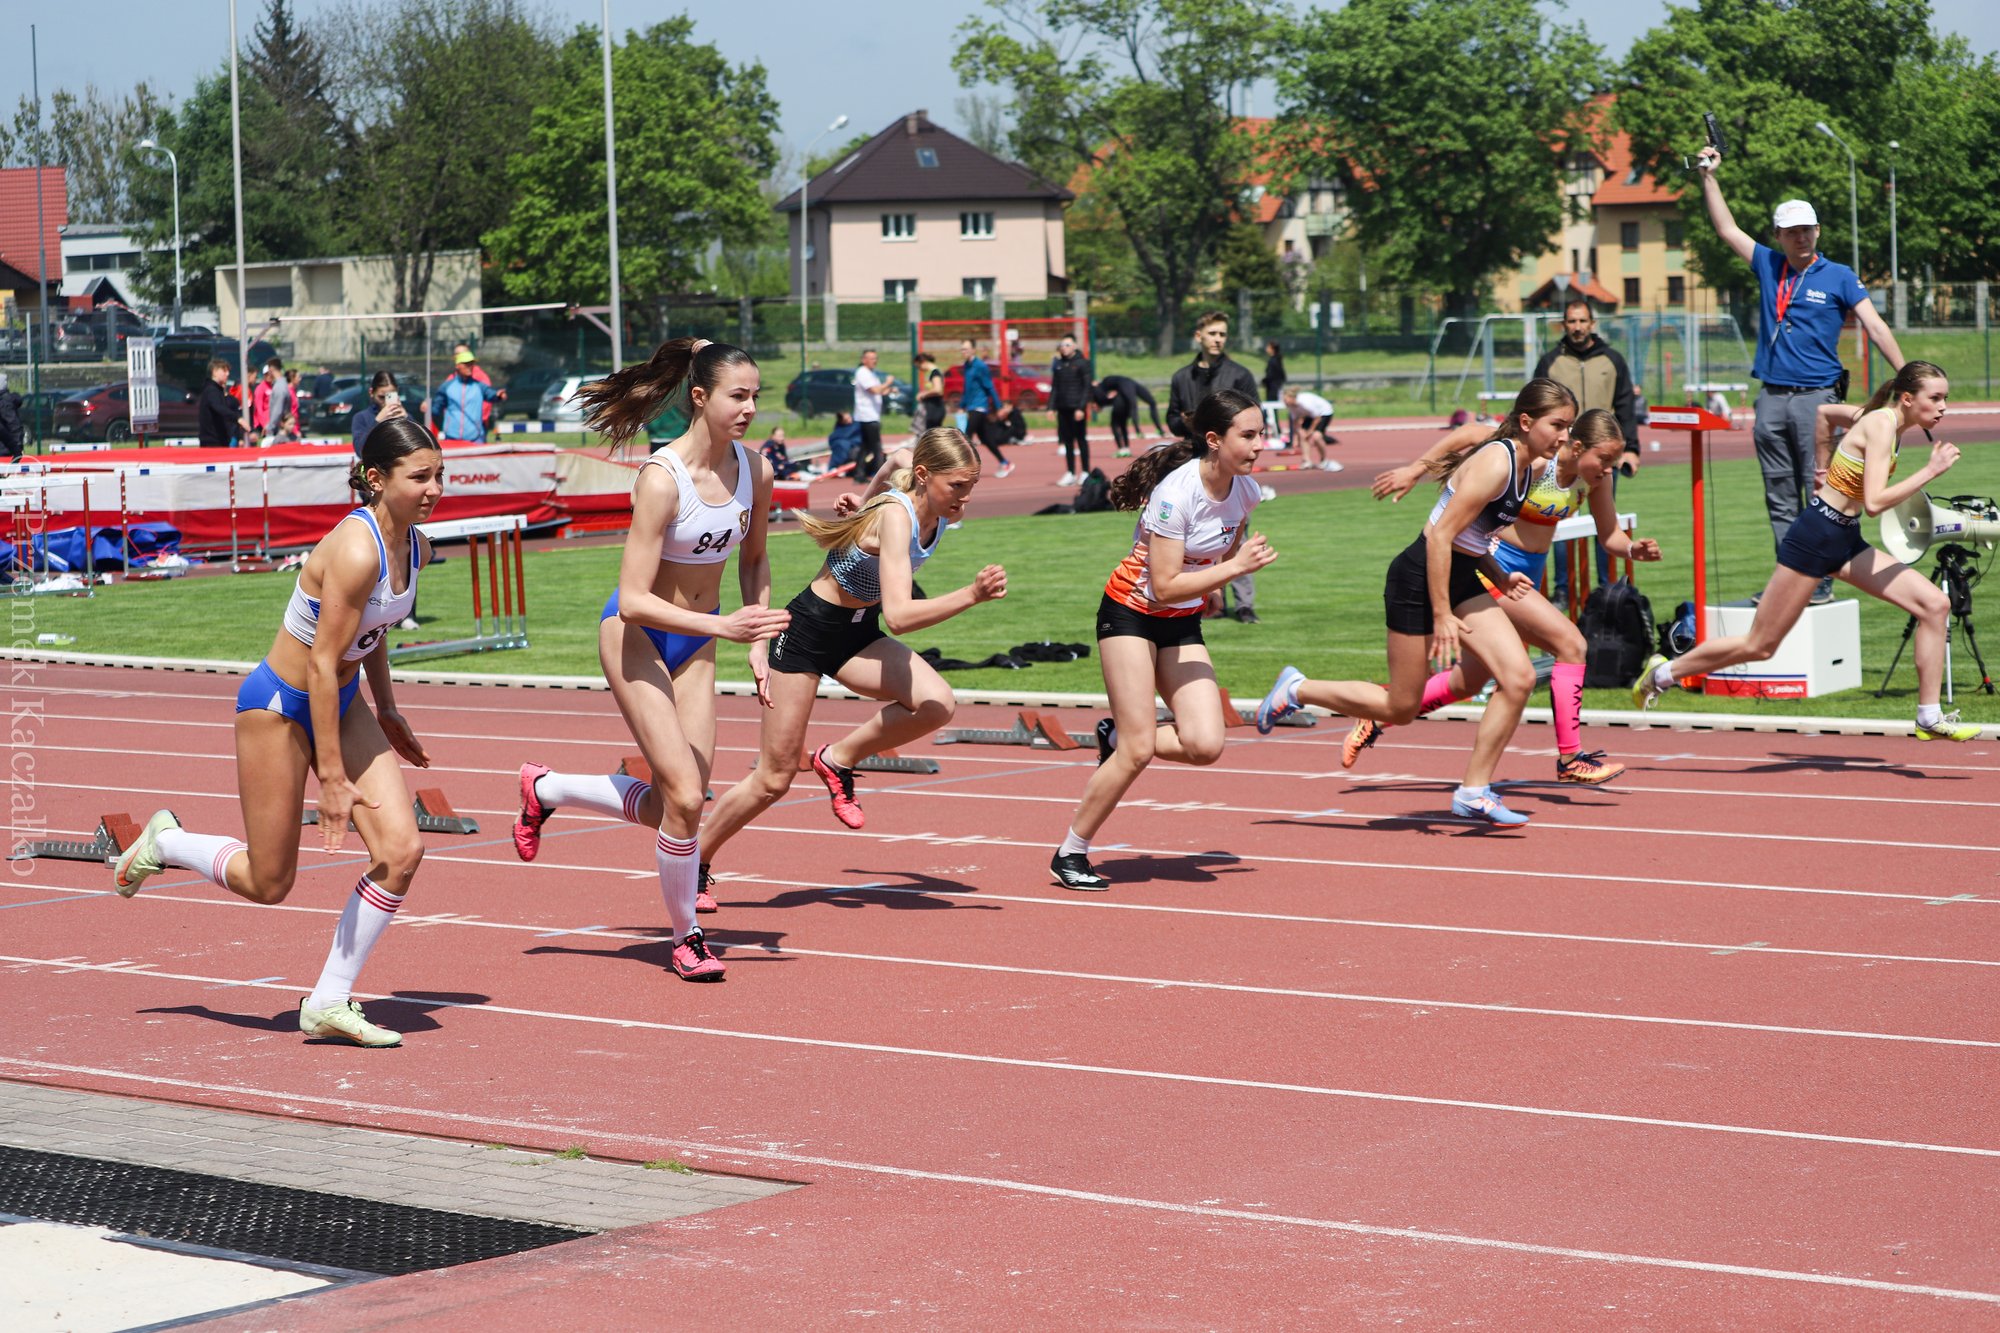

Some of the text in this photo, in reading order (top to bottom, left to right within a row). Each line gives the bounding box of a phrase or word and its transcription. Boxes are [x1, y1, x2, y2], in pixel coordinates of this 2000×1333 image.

[449, 473, 501, 485] POLANIK
[1540, 504, 1571, 519] 44
[1819, 505, 1848, 525] NIKE
[692, 528, 733, 554] 84
